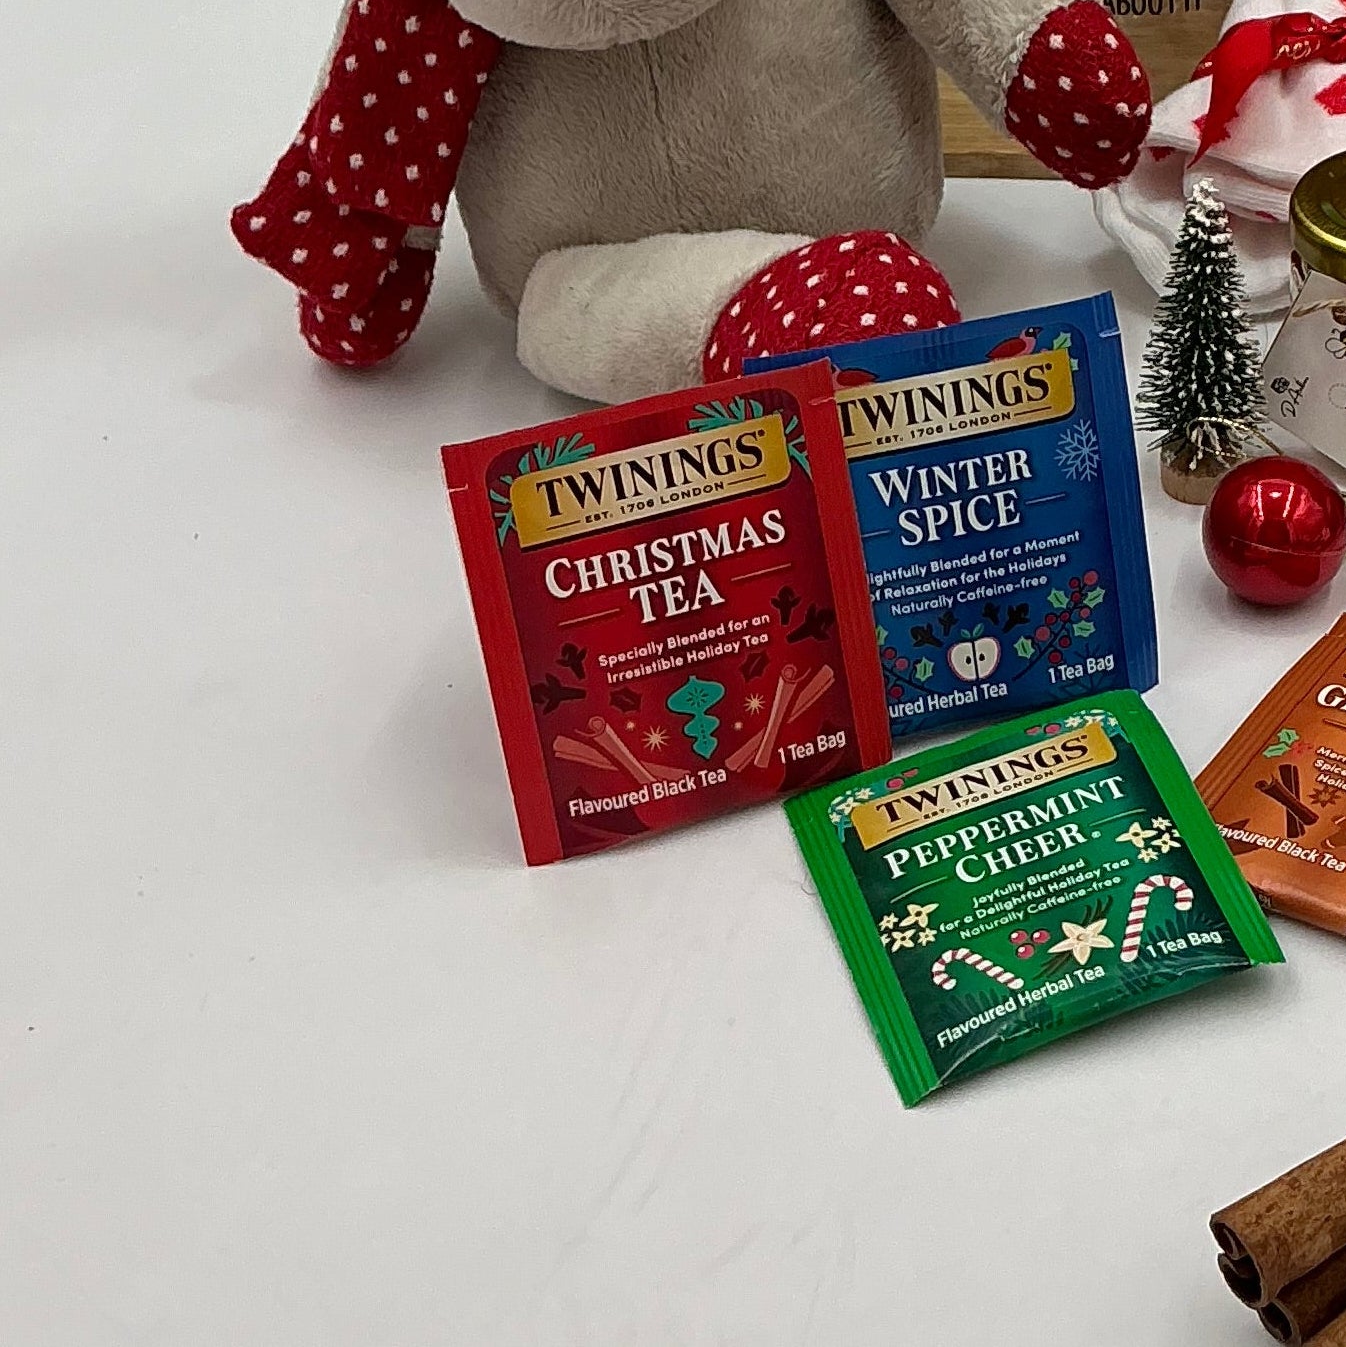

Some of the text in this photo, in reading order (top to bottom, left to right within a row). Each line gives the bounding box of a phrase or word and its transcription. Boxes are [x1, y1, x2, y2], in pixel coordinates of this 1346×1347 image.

[836, 364, 1050, 438] TWININGS
[910, 425, 944, 439] 1706
[949, 412, 1012, 431] LONDON
[536, 431, 764, 517] TWININGS
[619, 498, 655, 515] 1706
[660, 481, 725, 505] LONDON
[868, 449, 1033, 508] WINTER
[898, 488, 1021, 546] SPICE
[545, 509, 786, 599] CHRISTMAS
[884, 553, 1067, 600] Relaxation for the Holidays
[930, 530, 1081, 573] Blended for Moment
[629, 568, 725, 624] TEA
[890, 575, 1048, 617] Naturally Caffeine-free
[598, 614, 770, 668] Specially Blended for an
[606, 633, 769, 684] Irresistible Holiday Tea
[1048, 653, 1115, 684] 1 Tea Bag
[927, 688, 979, 712] Herbal
[980, 681, 1008, 700] Tea
[777, 730, 846, 764] 1 Tea Bag
[568, 768, 727, 817] Flavoured Black Tea
[876, 737, 1089, 824] TWININGS
[883, 775, 1127, 880] PEPPERMINT
[1277, 838, 1346, 872] Black Tea
[939, 858, 1130, 933] for a Delightful Holiday Tea
[959, 876, 1122, 940] Naturally Caffeine-free
[973, 858, 1086, 908] Joyfully Blended
[1146, 930, 1223, 958] 1 Tea Bag
[936, 964, 1106, 1048] Flavoured Herbal Tea
